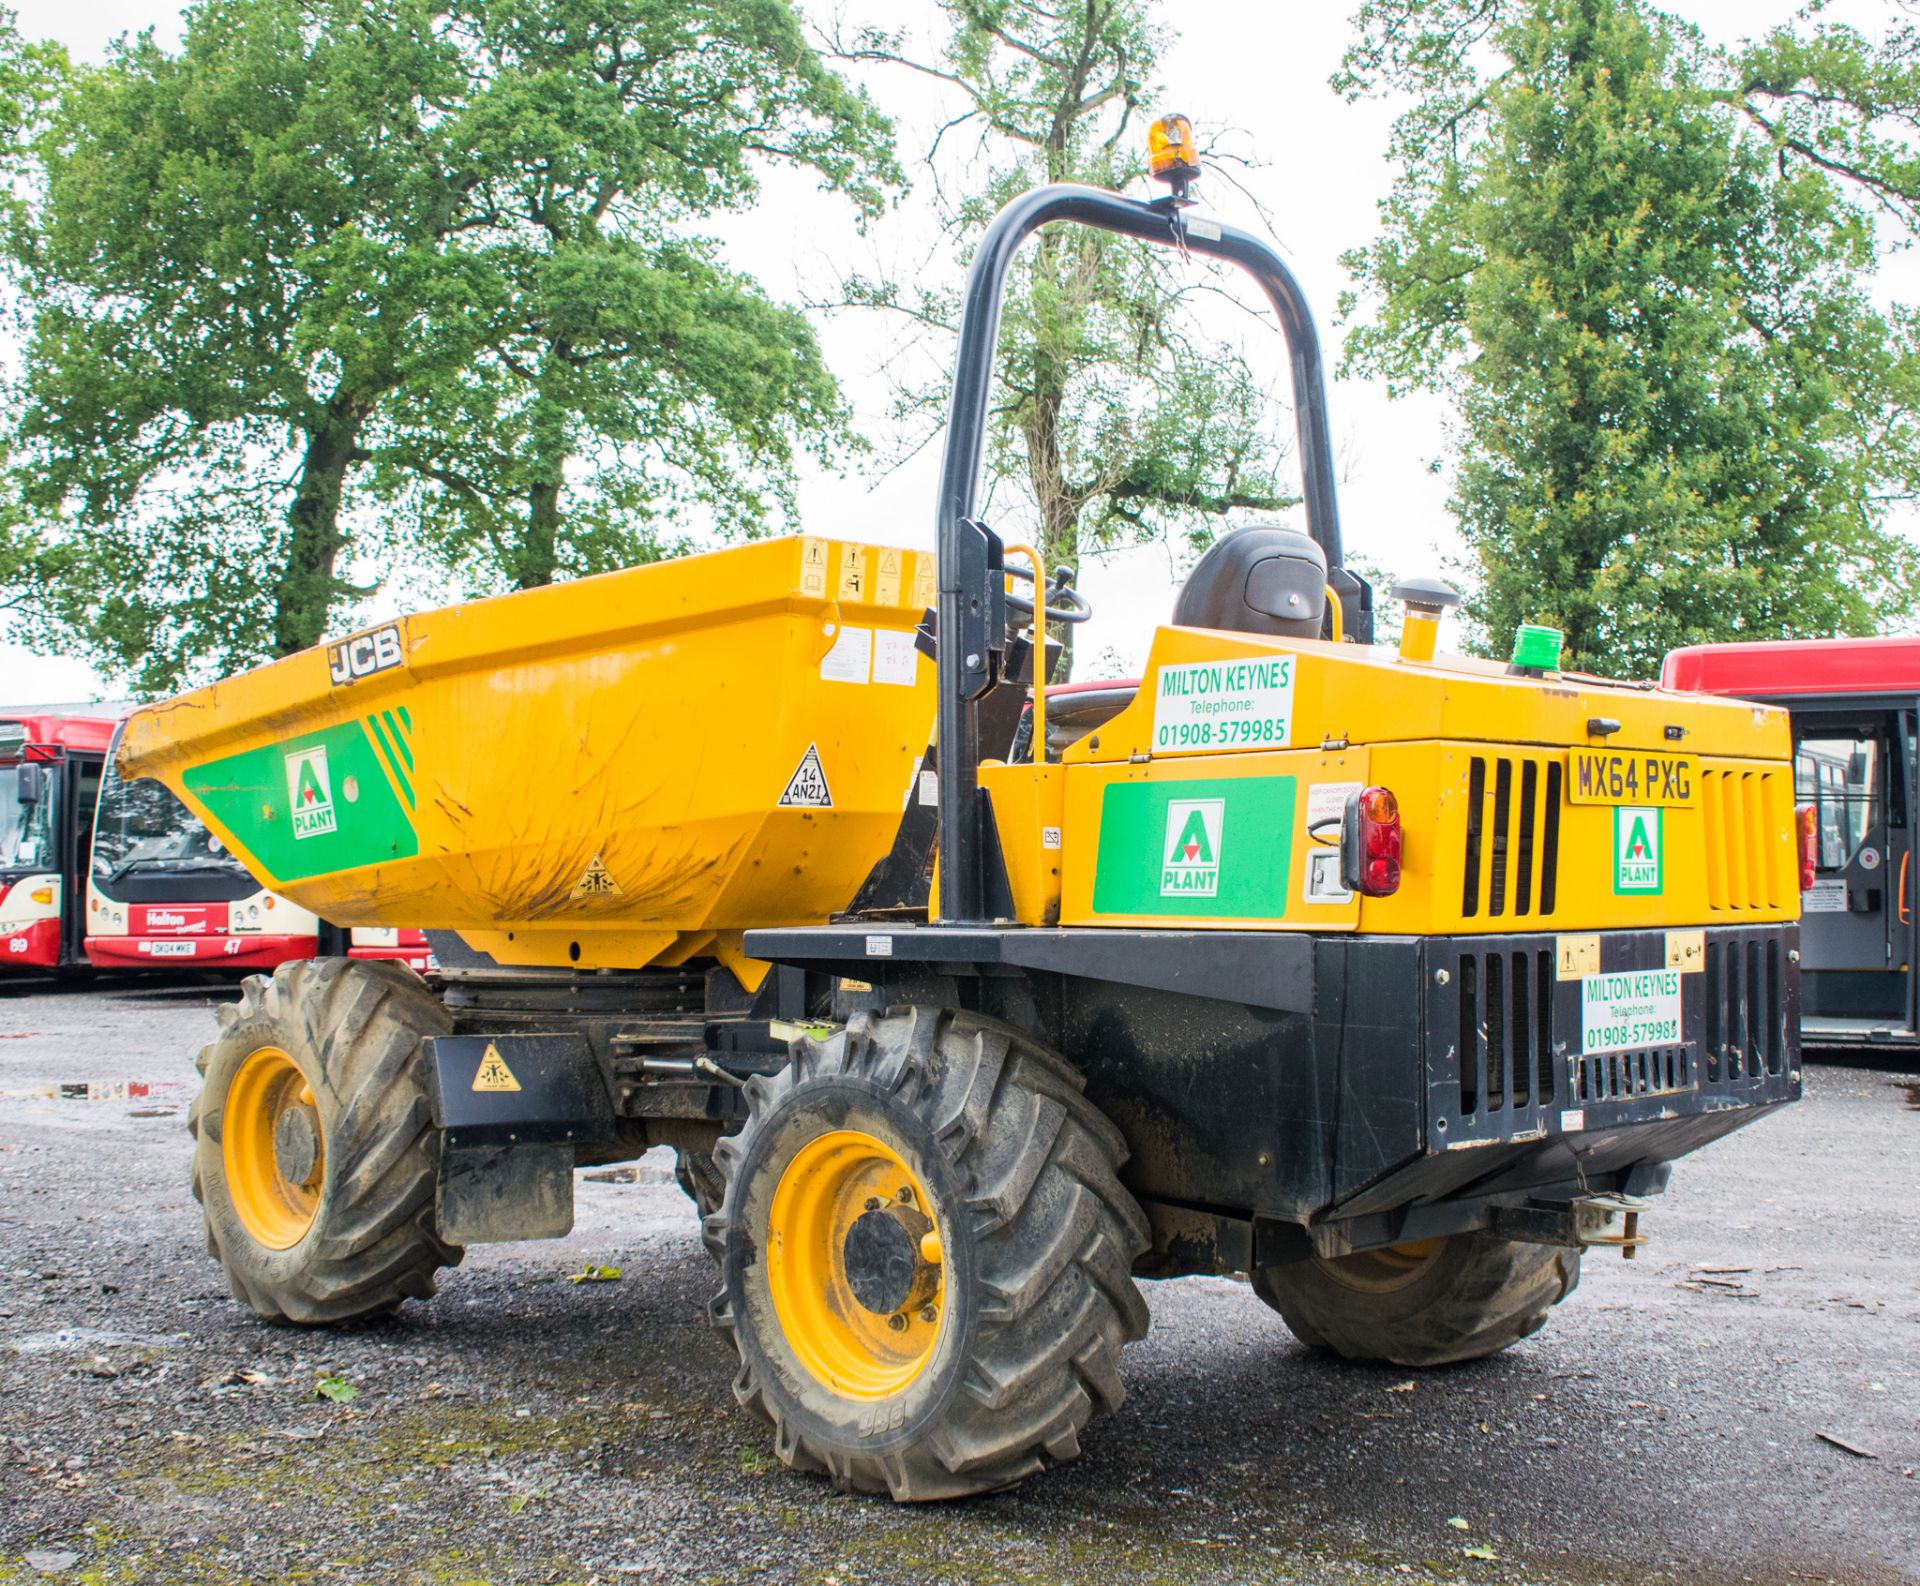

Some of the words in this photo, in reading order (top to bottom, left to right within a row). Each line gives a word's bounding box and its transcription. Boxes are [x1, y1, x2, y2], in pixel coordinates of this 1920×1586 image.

[330, 628, 401, 682] JCB
[1162, 667, 1222, 696] MILTON
[1225, 661, 1289, 692] KEYNES
[1190, 699, 1254, 716] Telephone:
[1159, 718, 1285, 746] 01908-579985
[296, 759, 327, 809] A
[802, 768, 816, 783] 14
[1578, 755, 1639, 798] MX64
[1646, 759, 1690, 799] PXG
[294, 809, 333, 833] PLANT
[1170, 810, 1213, 862] A
[1625, 816, 1653, 859] A
[1163, 871, 1216, 889] PLANT
[1621, 867, 1655, 882] PLANT
[146, 912, 185, 926] Halton
[9, 938, 28, 952] 89
[224, 939, 242, 954] 47
[1587, 977, 1632, 1002] MILTON
[1635, 973, 1677, 997] KEYNES
[1587, 1020, 1677, 1048] 01908-579985
